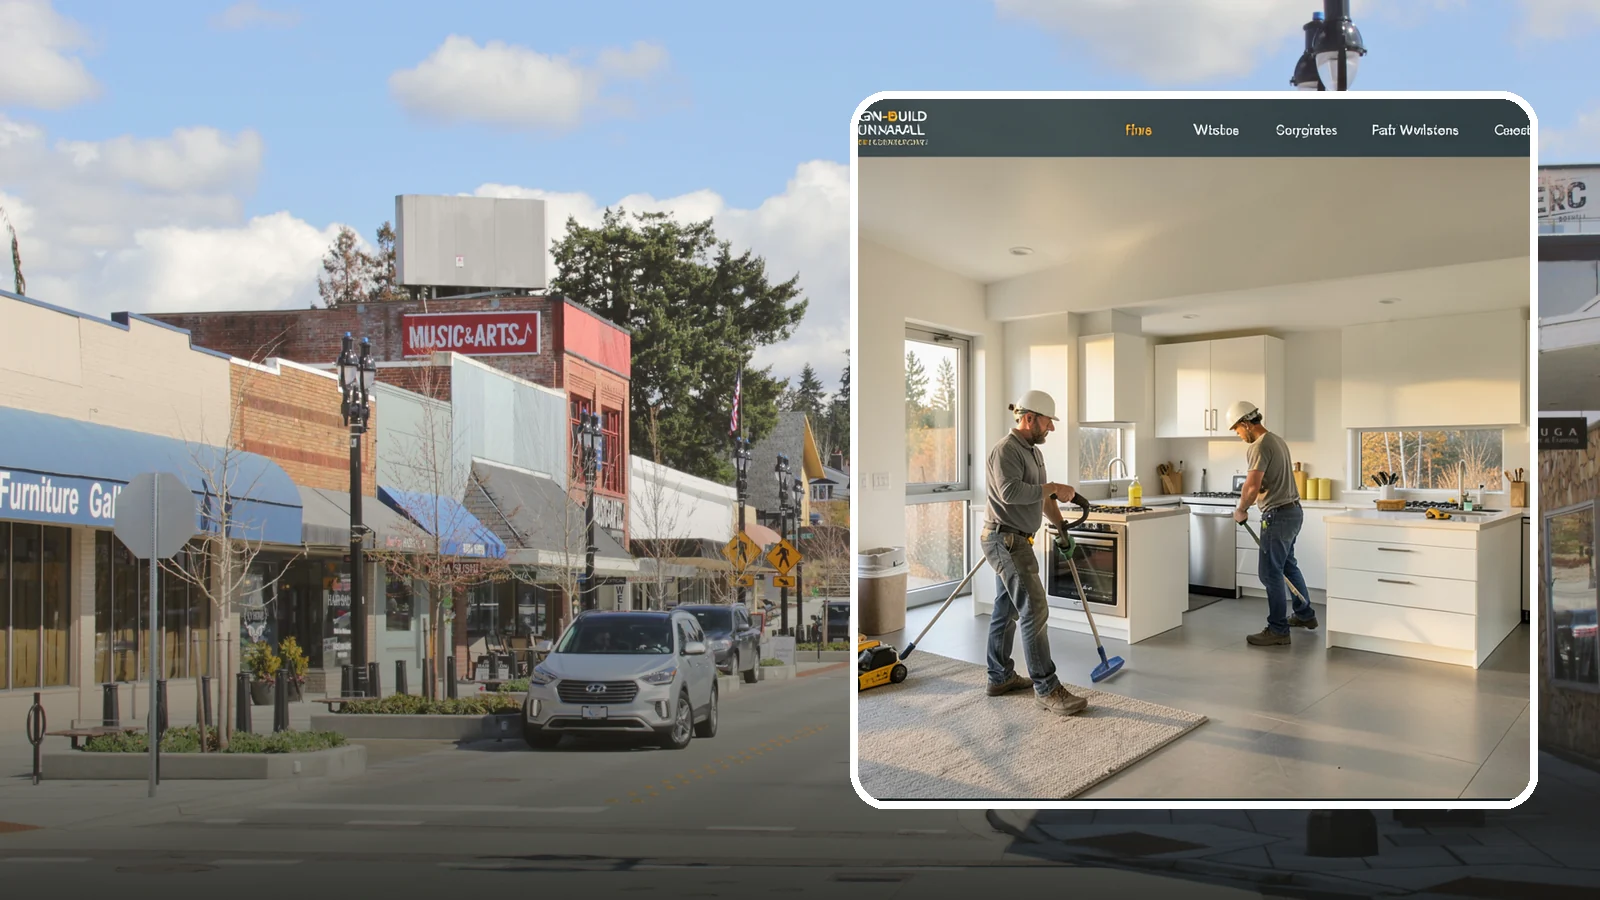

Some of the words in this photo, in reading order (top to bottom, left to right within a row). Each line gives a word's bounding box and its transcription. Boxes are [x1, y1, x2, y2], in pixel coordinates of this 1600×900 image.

[409, 323, 519, 349] MUSIC&ARTS
[0, 471, 79, 515] Furniture
[89, 482, 122, 519] Gal
